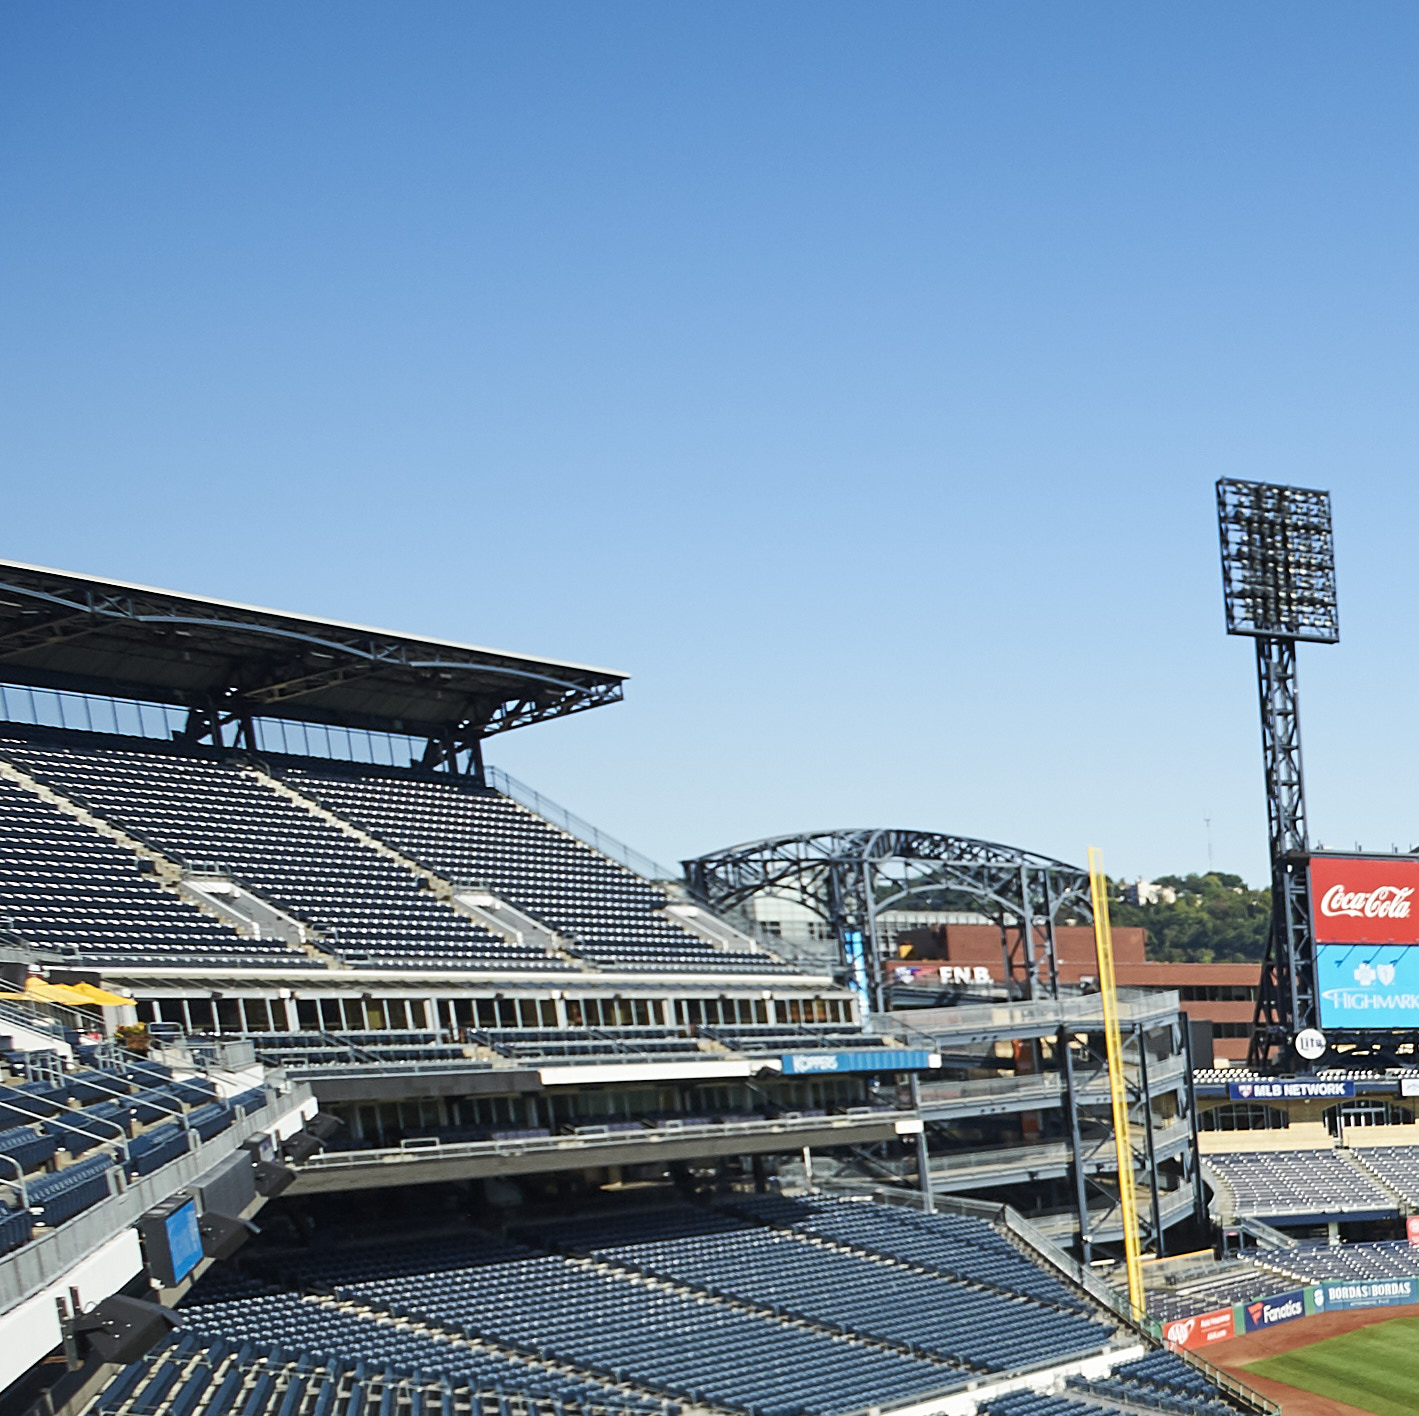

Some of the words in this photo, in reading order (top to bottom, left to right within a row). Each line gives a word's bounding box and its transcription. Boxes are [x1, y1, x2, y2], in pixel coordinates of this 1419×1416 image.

[1320, 884, 1416, 919] Coca-Cola
[939, 966, 994, 985] F.N.B.
[1253, 1083, 1283, 1097] MLB
[1284, 1082, 1346, 1096] NETWORK
[1328, 1285, 1368, 1301] BORDAS
[1371, 1281, 1411, 1297] BORDAS
[1263, 1299, 1303, 1324] Fanatics
